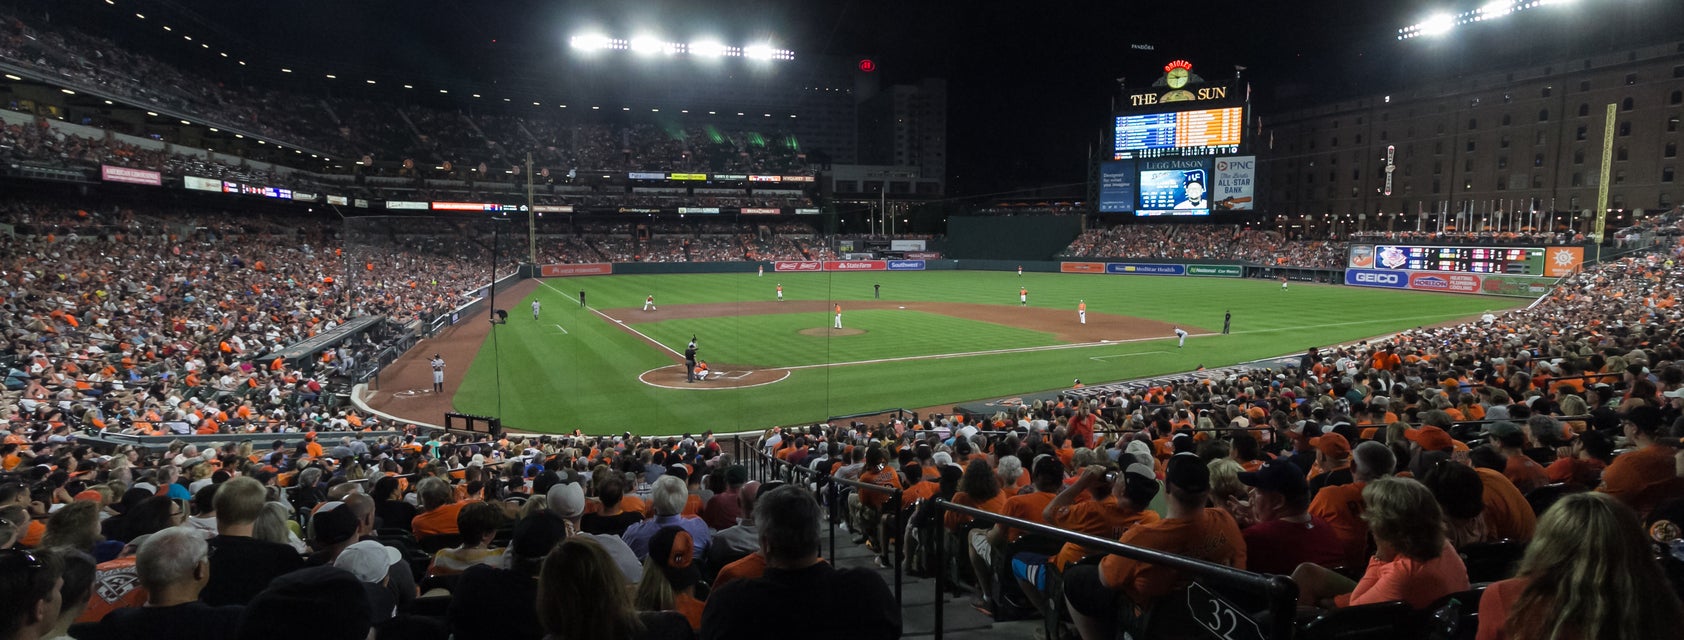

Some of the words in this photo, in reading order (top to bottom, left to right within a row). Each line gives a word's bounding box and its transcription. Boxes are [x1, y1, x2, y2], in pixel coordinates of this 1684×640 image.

[1164, 60, 1192, 73] ORIOLES
[1131, 93, 1158, 106] THE
[1198, 87, 1226, 100] SUN
[1171, 160, 1203, 168] MASON
[1230, 161, 1253, 170] PNC
[1356, 272, 1399, 284] GEICO
[1414, 280, 1447, 288] HORIZON
[1209, 599, 1238, 640] 32
